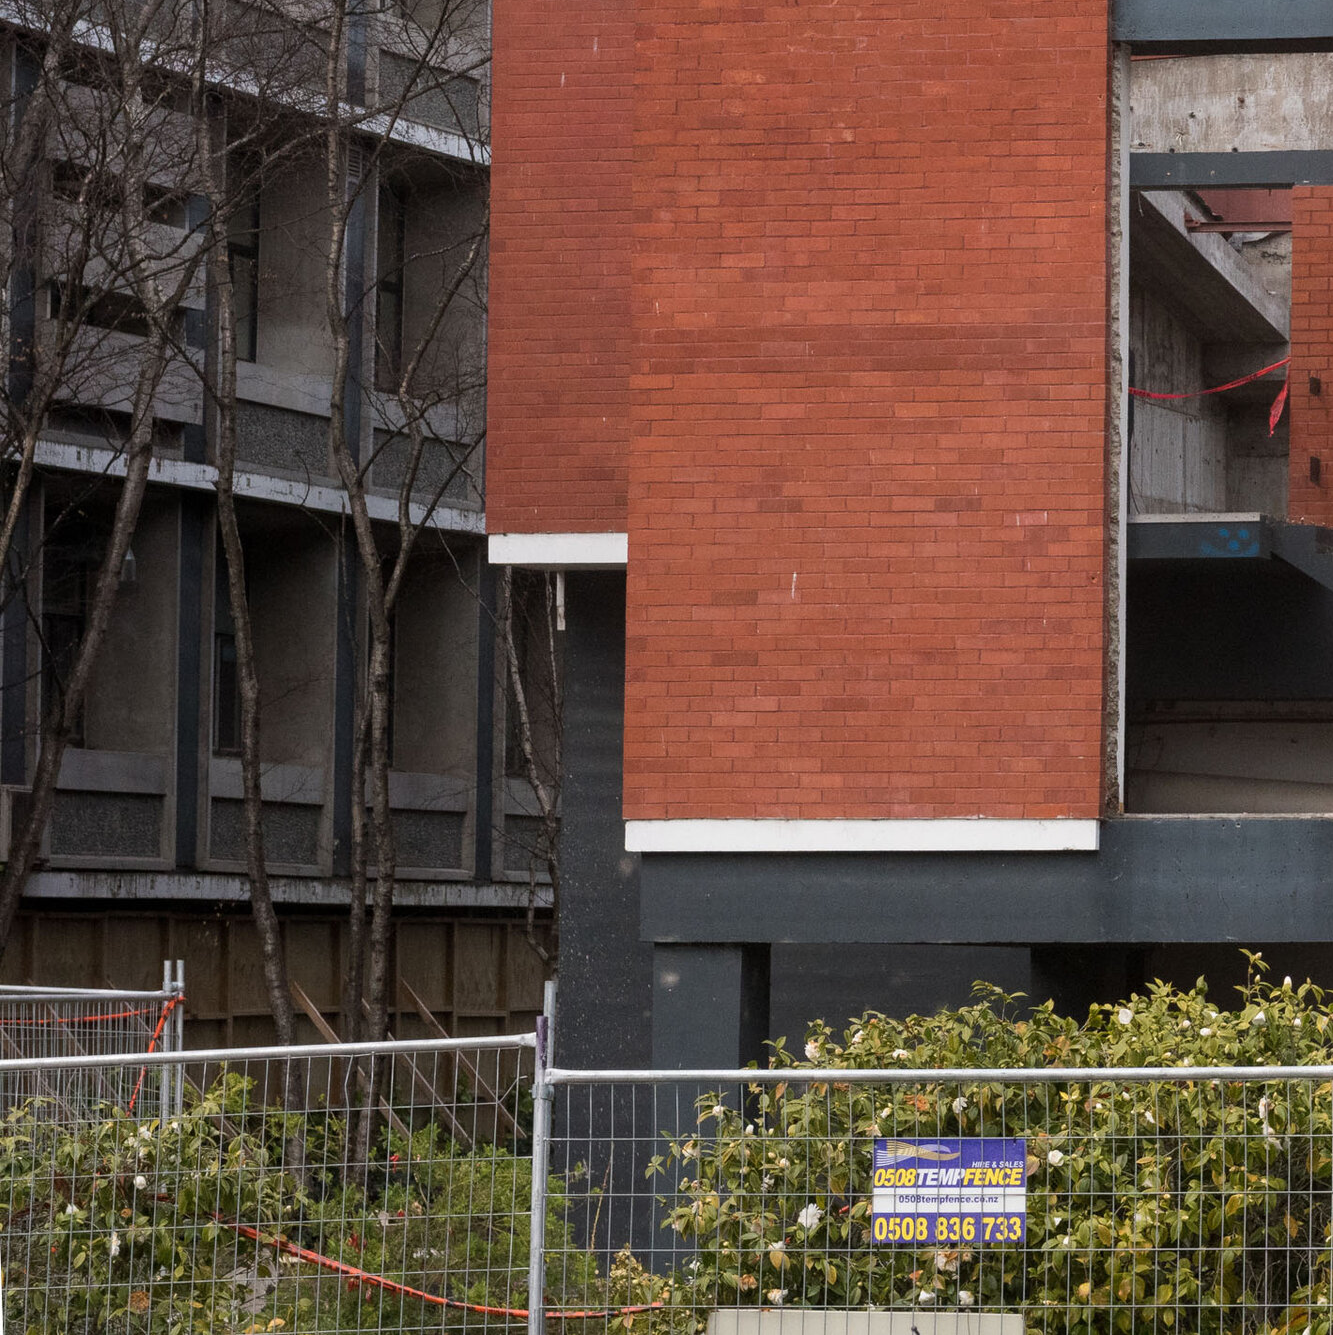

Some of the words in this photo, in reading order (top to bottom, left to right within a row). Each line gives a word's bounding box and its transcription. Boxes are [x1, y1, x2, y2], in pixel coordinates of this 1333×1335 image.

[991, 1160, 997, 1168] &
[999, 1160, 1024, 1168] SALES
[898, 1195, 999, 1204] 0508tempfence.co.nz
[874, 1217, 928, 1241] 0508
[936, 1217, 975, 1241] 836
[982, 1217, 1022, 1241] 733
